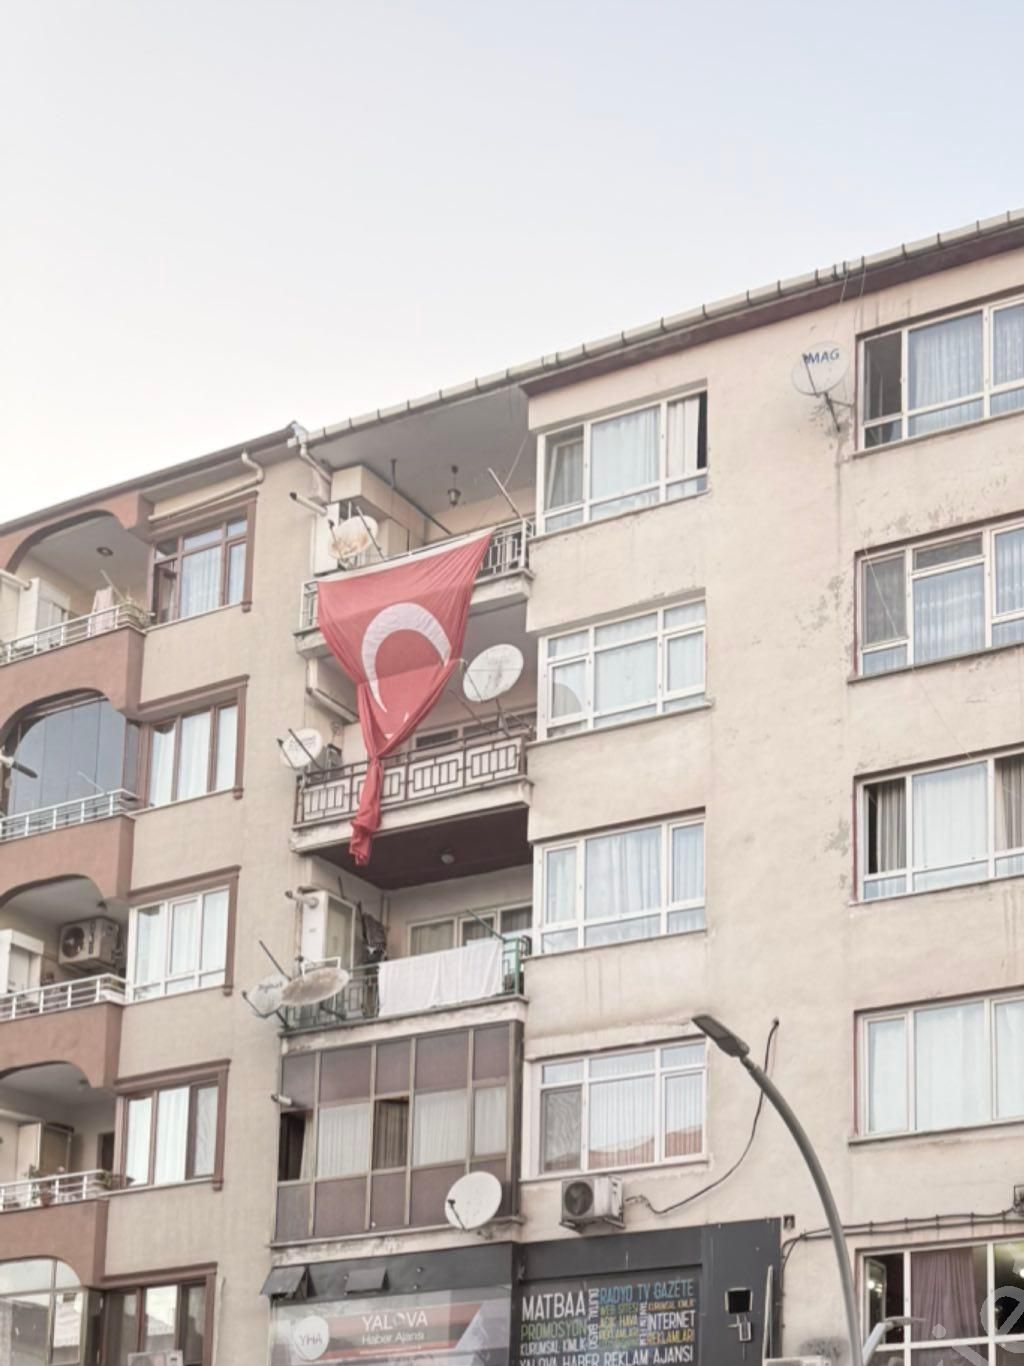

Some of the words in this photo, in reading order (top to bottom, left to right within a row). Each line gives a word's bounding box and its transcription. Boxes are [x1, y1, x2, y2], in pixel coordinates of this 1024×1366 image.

[522, 1290, 587, 1322] MATBAA
[363, 1334, 393, 1345] Haber
[520, 1320, 588, 1341] PROMOSYON
[653, 1345, 693, 1364] AJANSI
